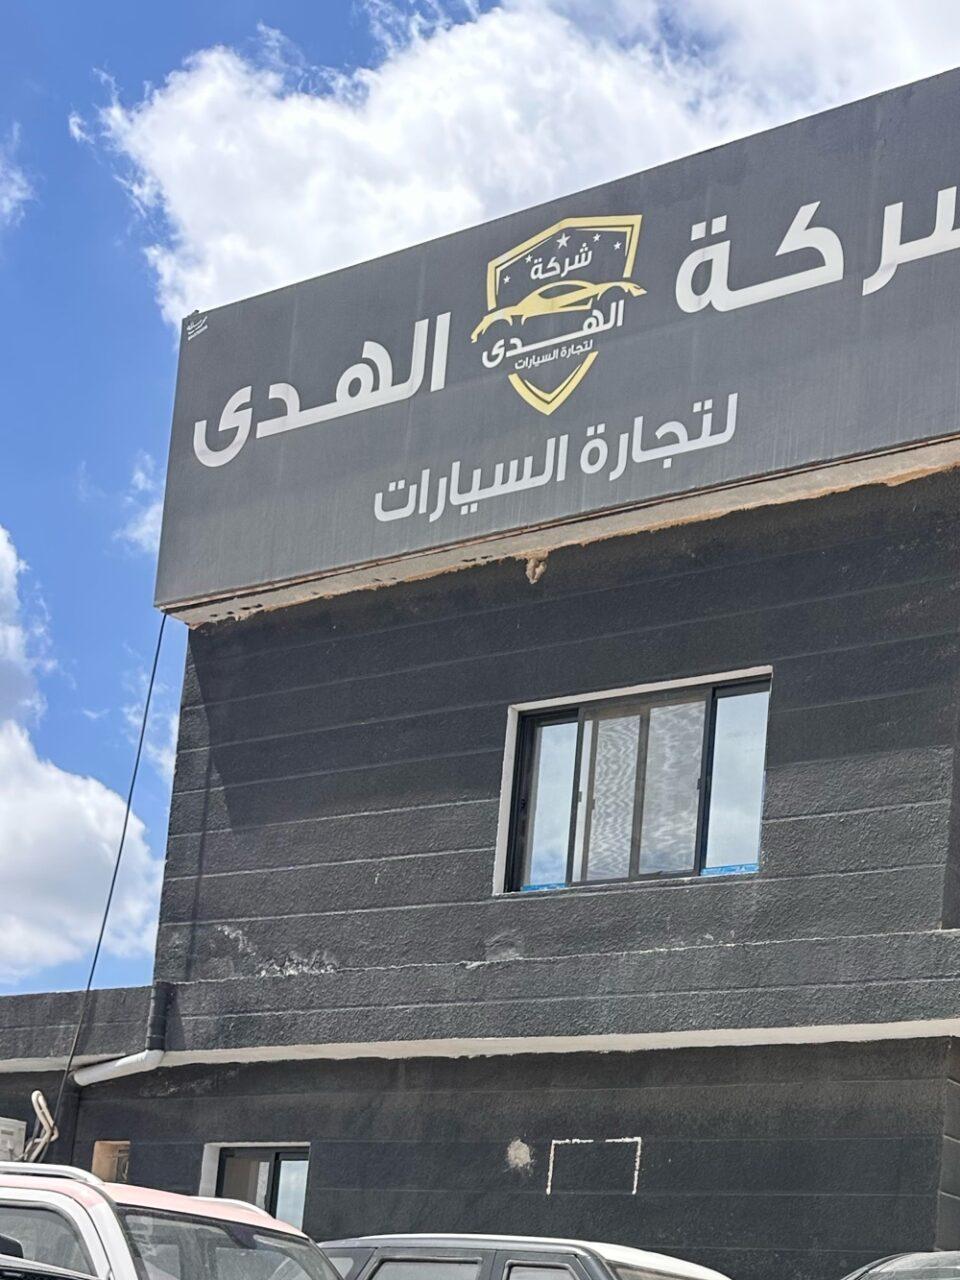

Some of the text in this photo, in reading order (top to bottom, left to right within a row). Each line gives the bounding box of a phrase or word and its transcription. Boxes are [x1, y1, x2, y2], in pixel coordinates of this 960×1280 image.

[530, 243, 593, 280] شركة
[482, 300, 625, 368] الهدى
[514, 339, 594, 370] لتجارة السيارات
[193, 311, 450, 468] الهدى
[373, 392, 740, 524] لتجارة السيارات
